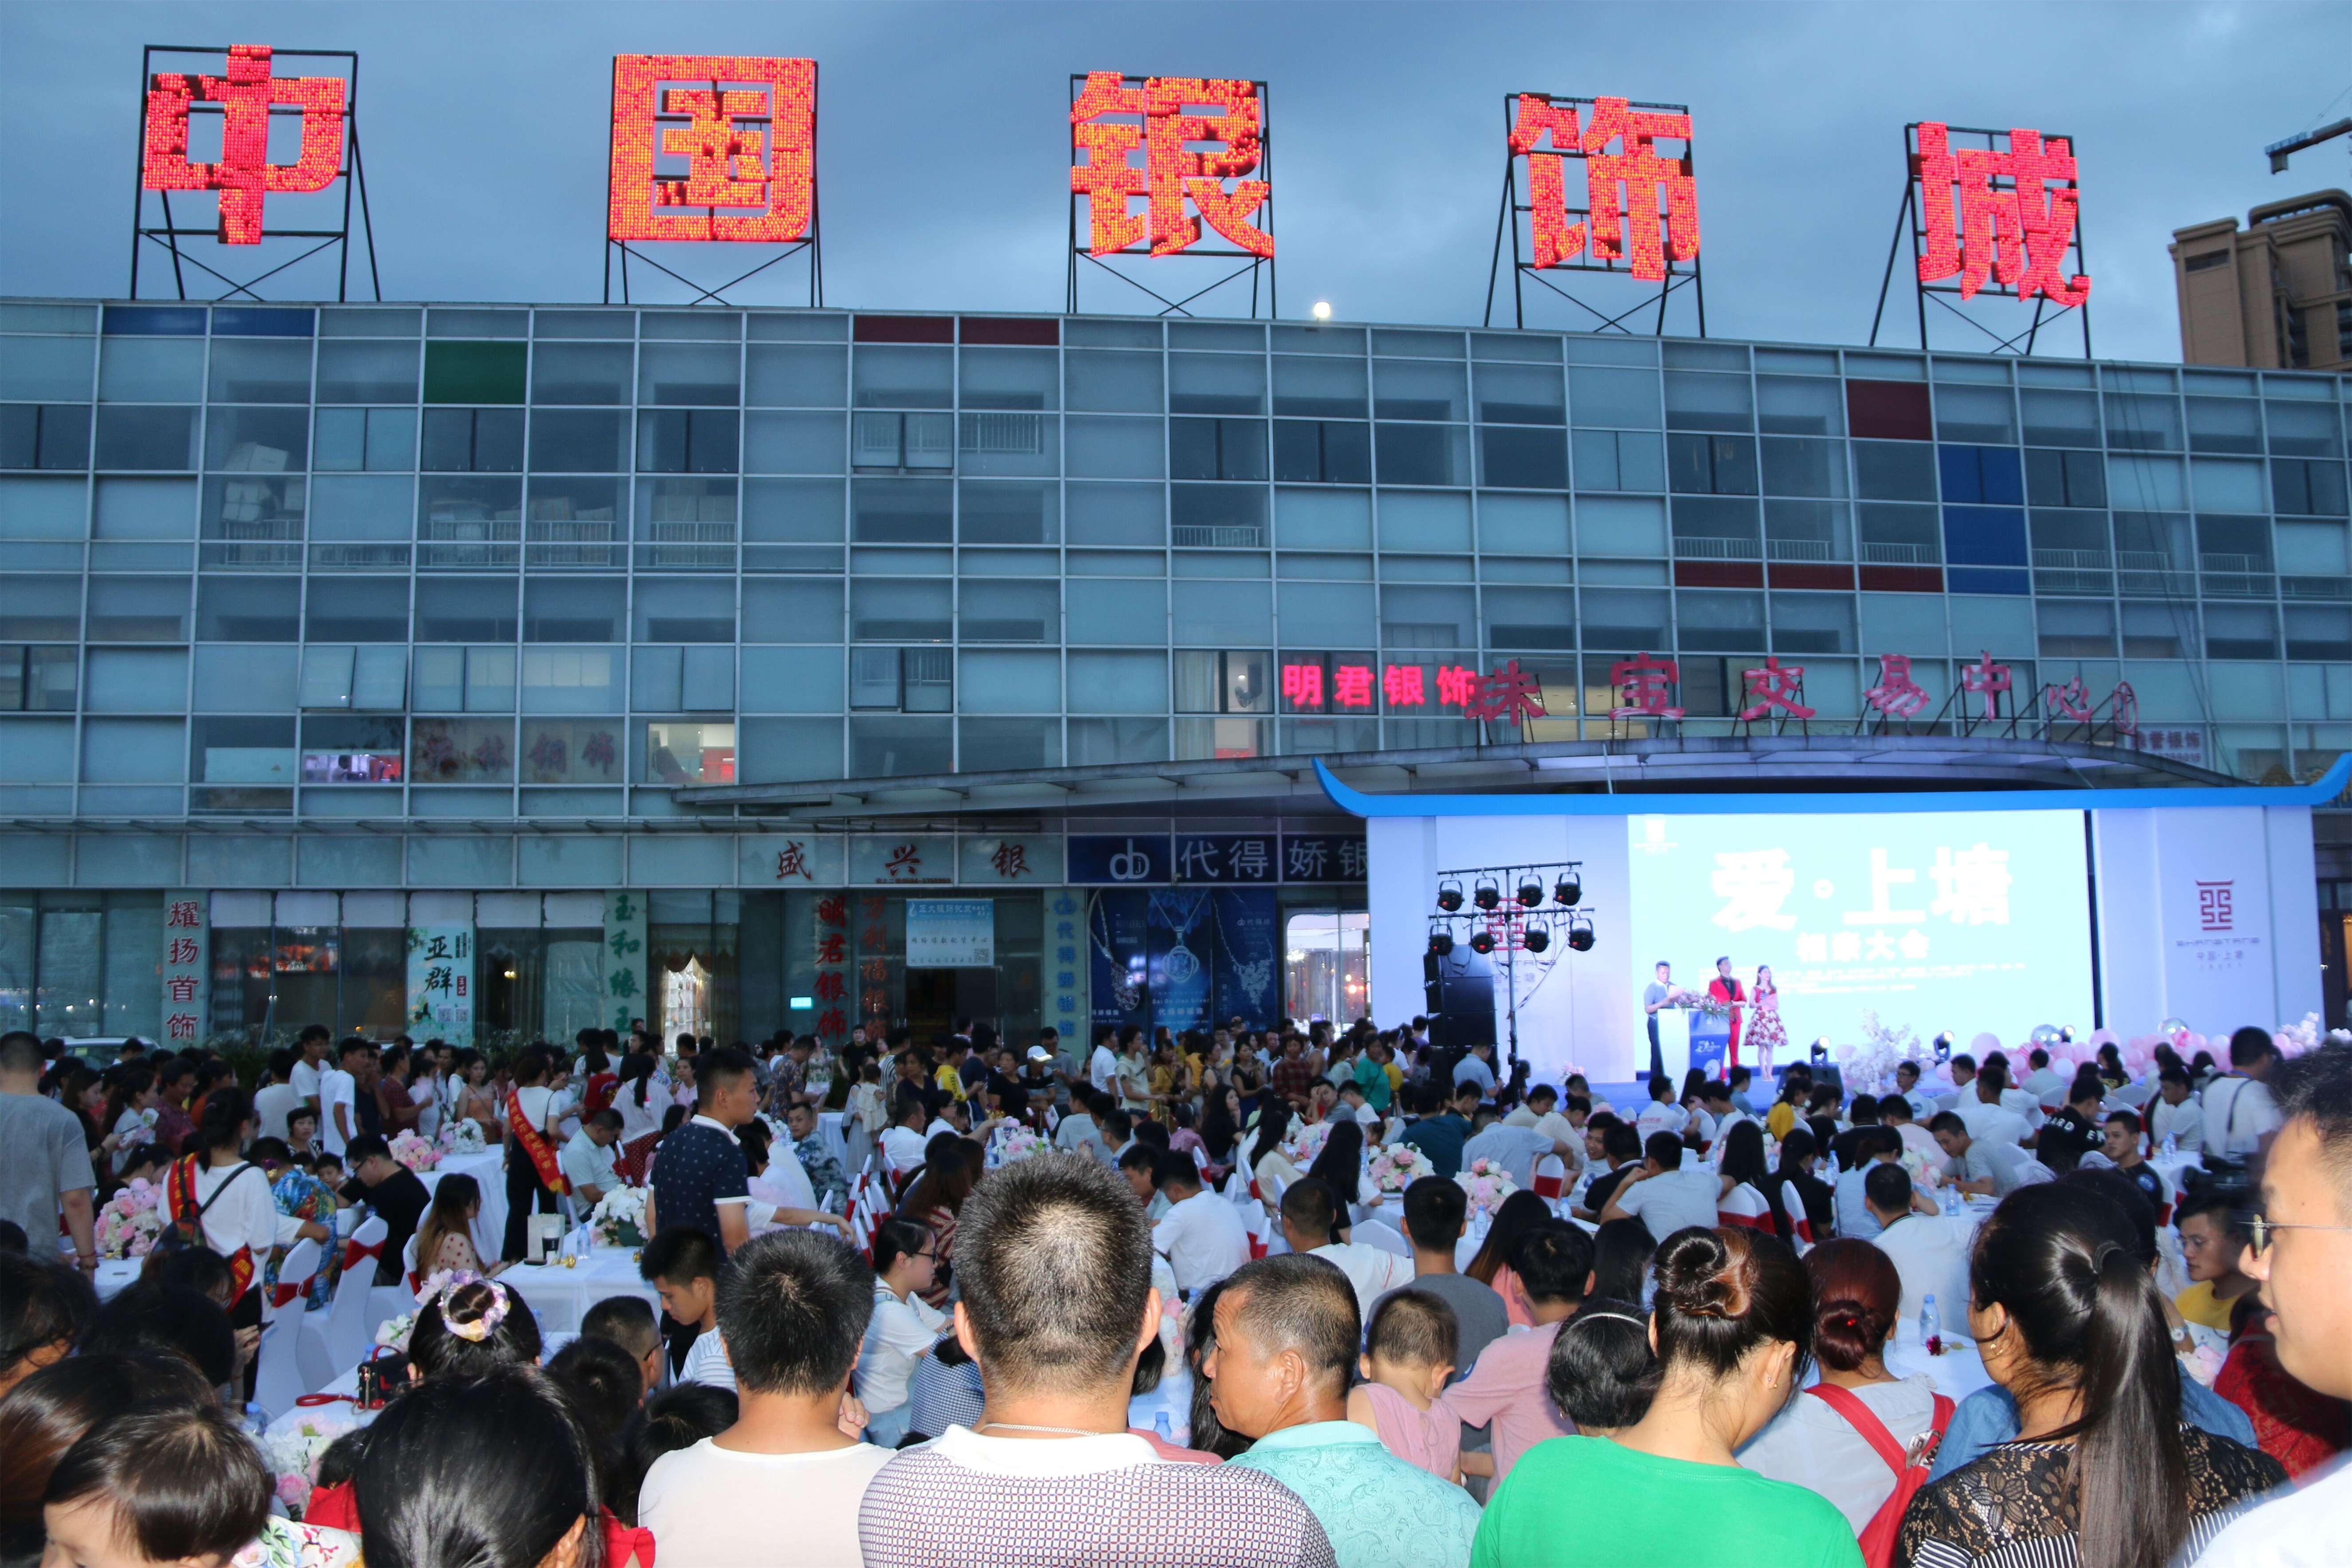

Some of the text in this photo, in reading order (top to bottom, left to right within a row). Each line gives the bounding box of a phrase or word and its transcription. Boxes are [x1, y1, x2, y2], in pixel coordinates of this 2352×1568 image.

[143, 43, 2091, 306] 中国银饰城
[1283, 665, 1476, 707] 明君银饰
[1464, 650, 2093, 726] 珠宝交易中心
[776, 840, 1031, 881] 盛兴银
[1180, 839, 1368, 878] 代得娇银
[166, 900, 201, 1040] 耀扬首饰
[423, 935, 453, 999] 亚群
[813, 894, 849, 1041] 明君银饰
[860, 896, 889, 1044] 万利福银饰
[1057, 921, 1075, 1037] 代得娇银饰
